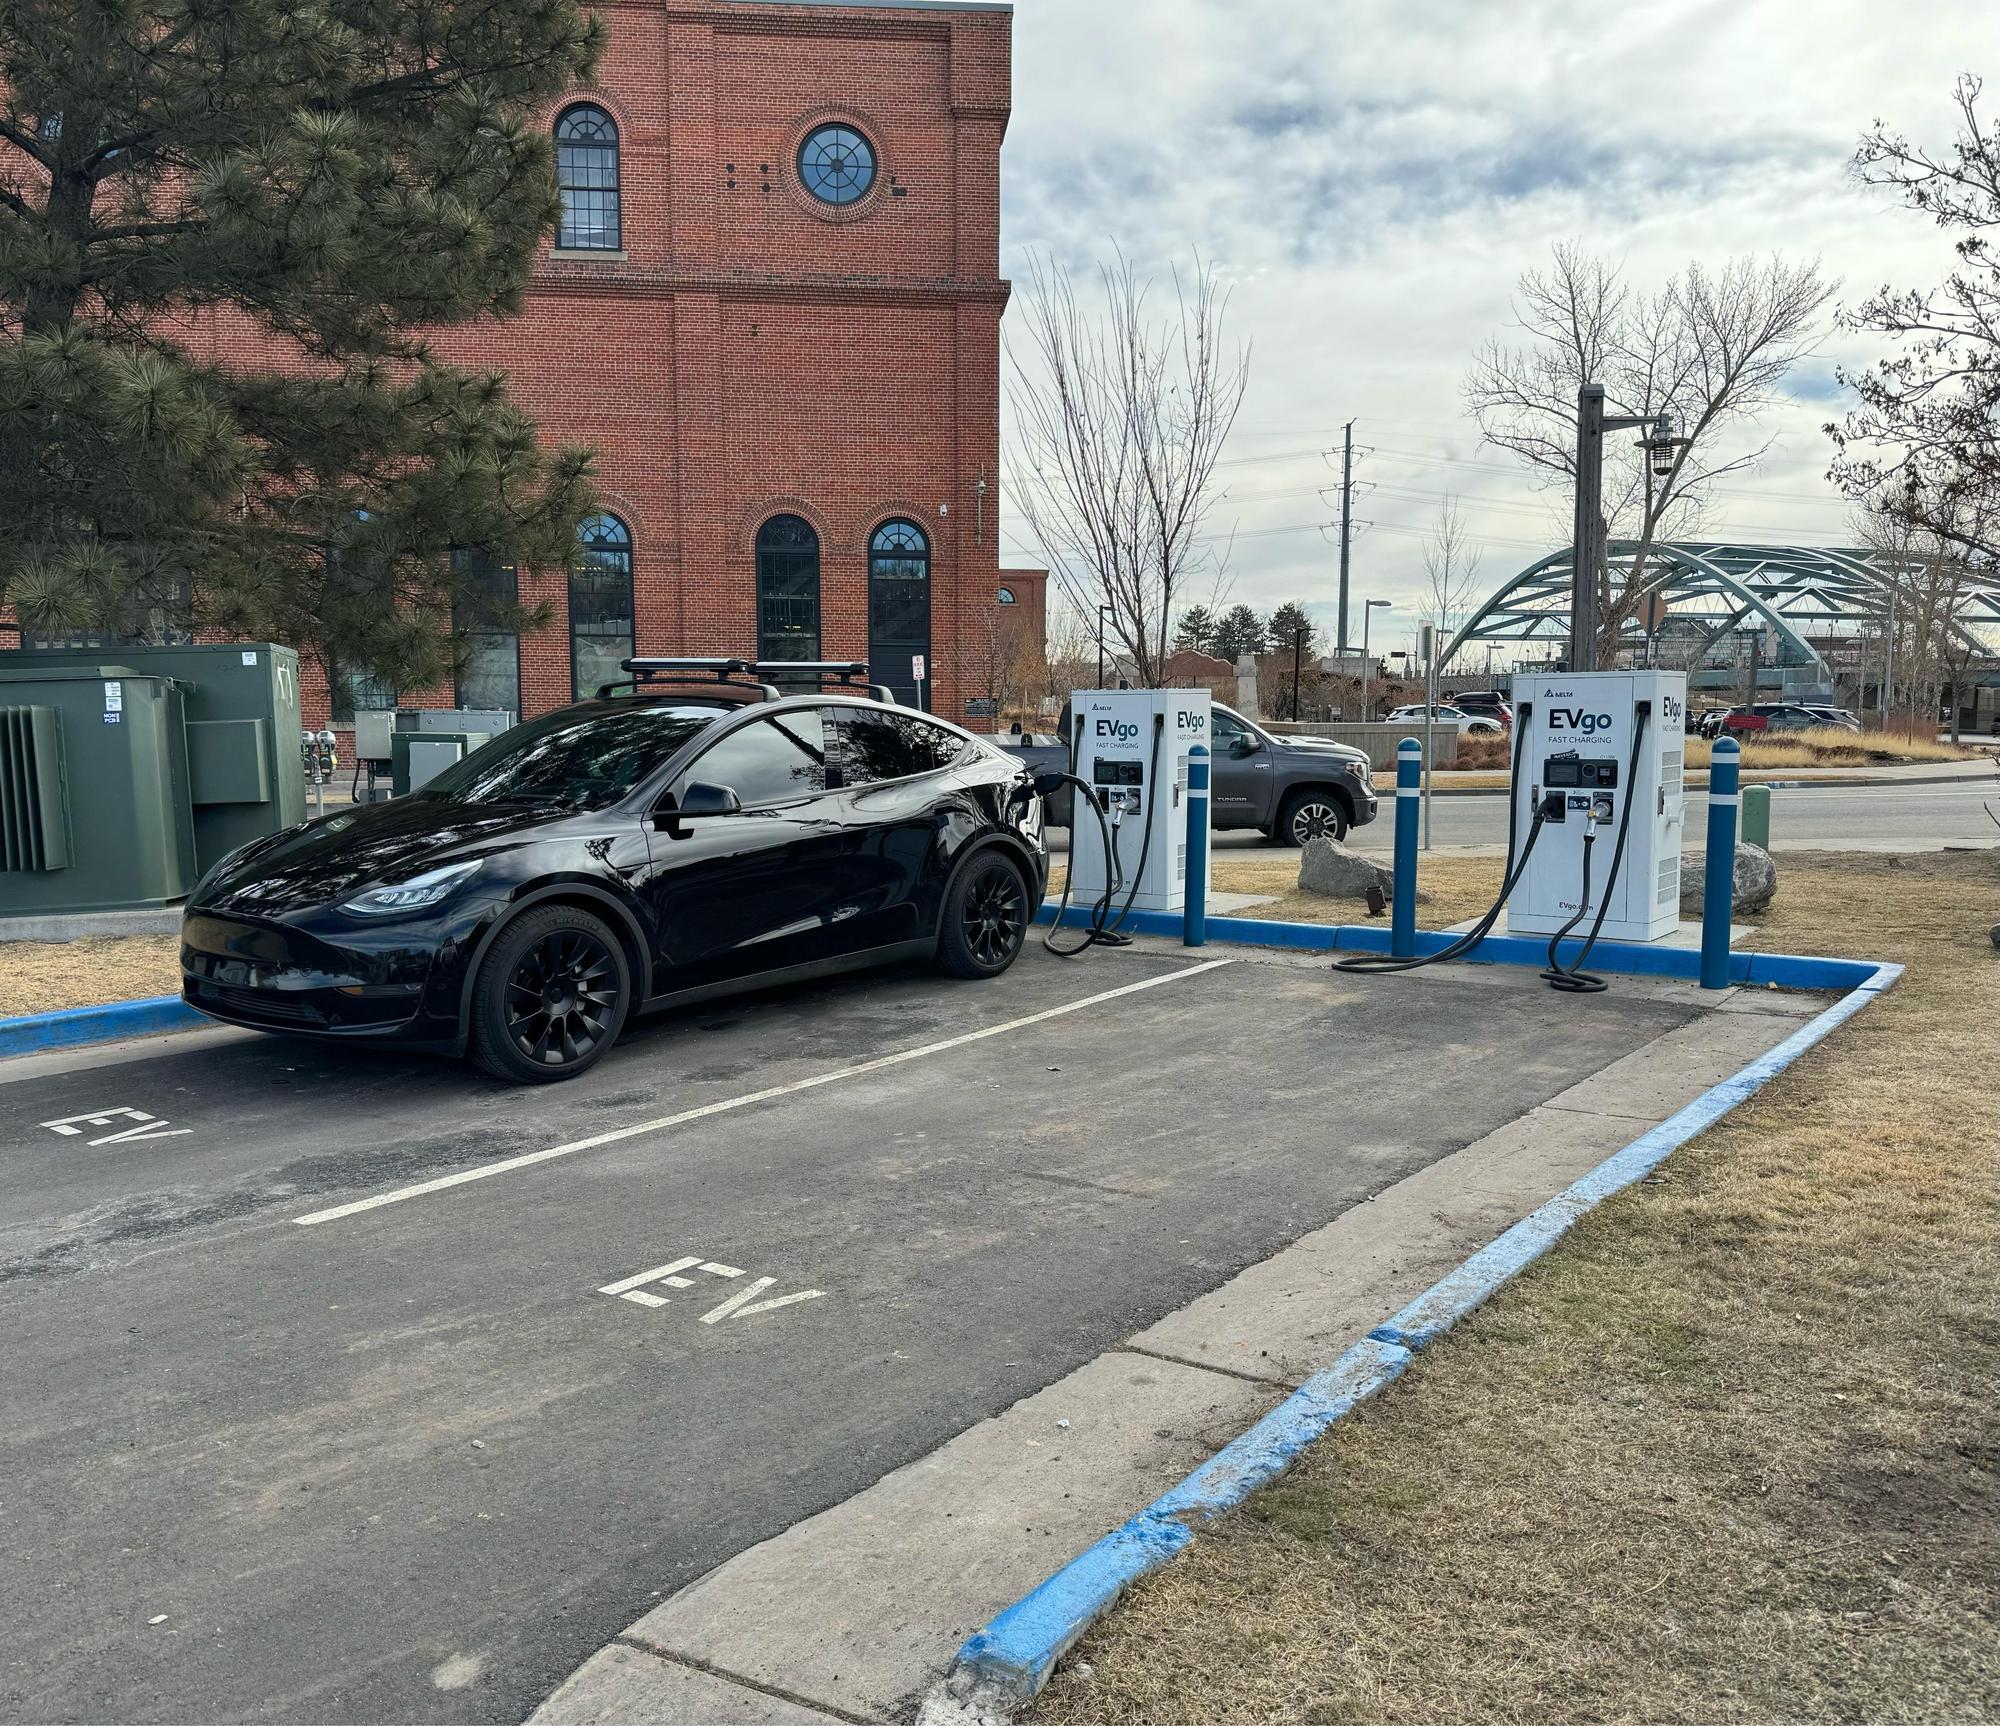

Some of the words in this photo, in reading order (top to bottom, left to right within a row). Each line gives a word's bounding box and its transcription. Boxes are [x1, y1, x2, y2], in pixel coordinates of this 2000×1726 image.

[1177, 711, 1204, 733] EVgo
[1549, 708, 1612, 735] EVgo
[1663, 696, 1681, 723] EVgo
[1096, 719, 1139, 742] EVgo
[1548, 736, 1567, 744] FAST
[1568, 736, 1612, 744] CHARGING
[39, 1106, 194, 1146] EV
[597, 1256, 827, 1325] EV
